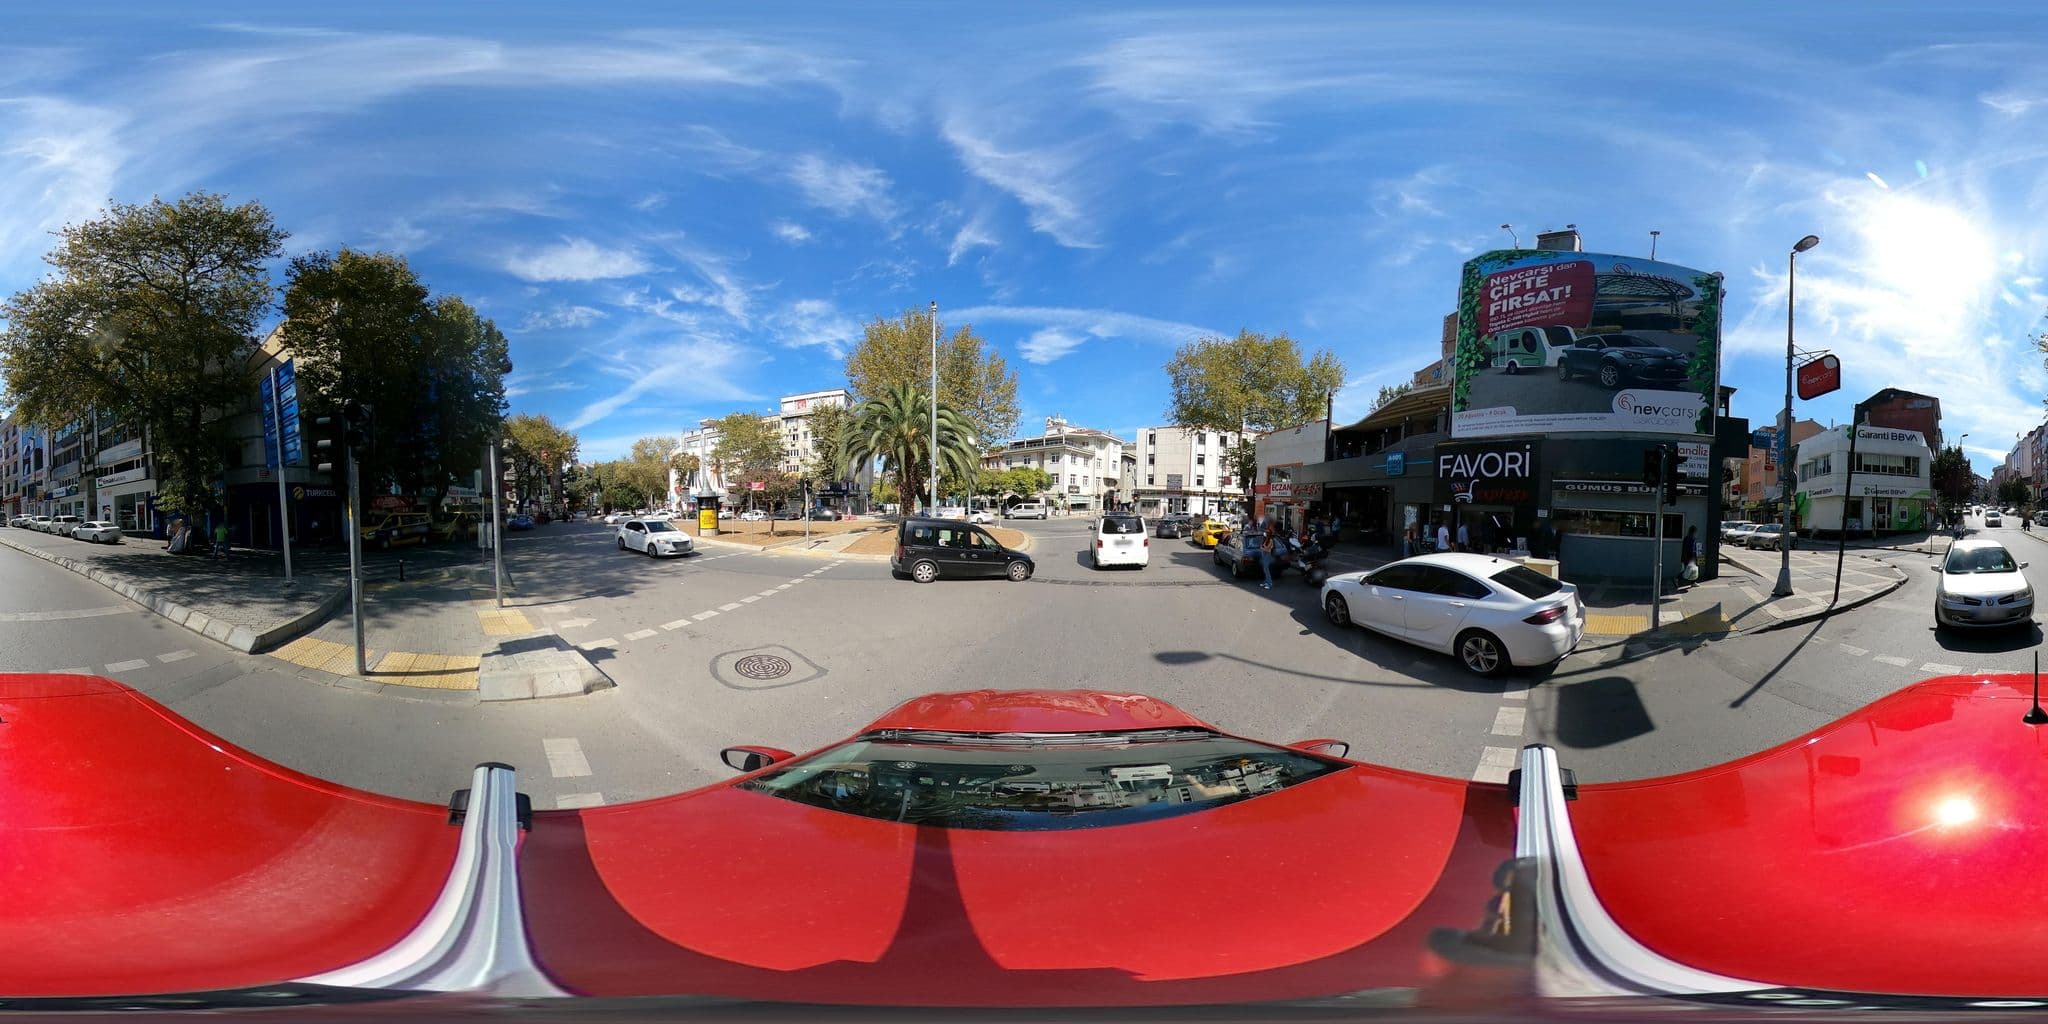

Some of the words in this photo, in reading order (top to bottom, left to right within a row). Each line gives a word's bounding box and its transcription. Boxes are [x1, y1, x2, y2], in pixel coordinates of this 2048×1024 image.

[1489, 285, 1572, 317] FIRSAT!
[1634, 405, 1697, 419] nevçarşı
[1858, 429, 1889, 440] Garanti
[1891, 432, 1918, 441] BBVA
[1439, 443, 1530, 478] FAVORİ
[1565, 483, 1623, 493] GÜMÜŞ
